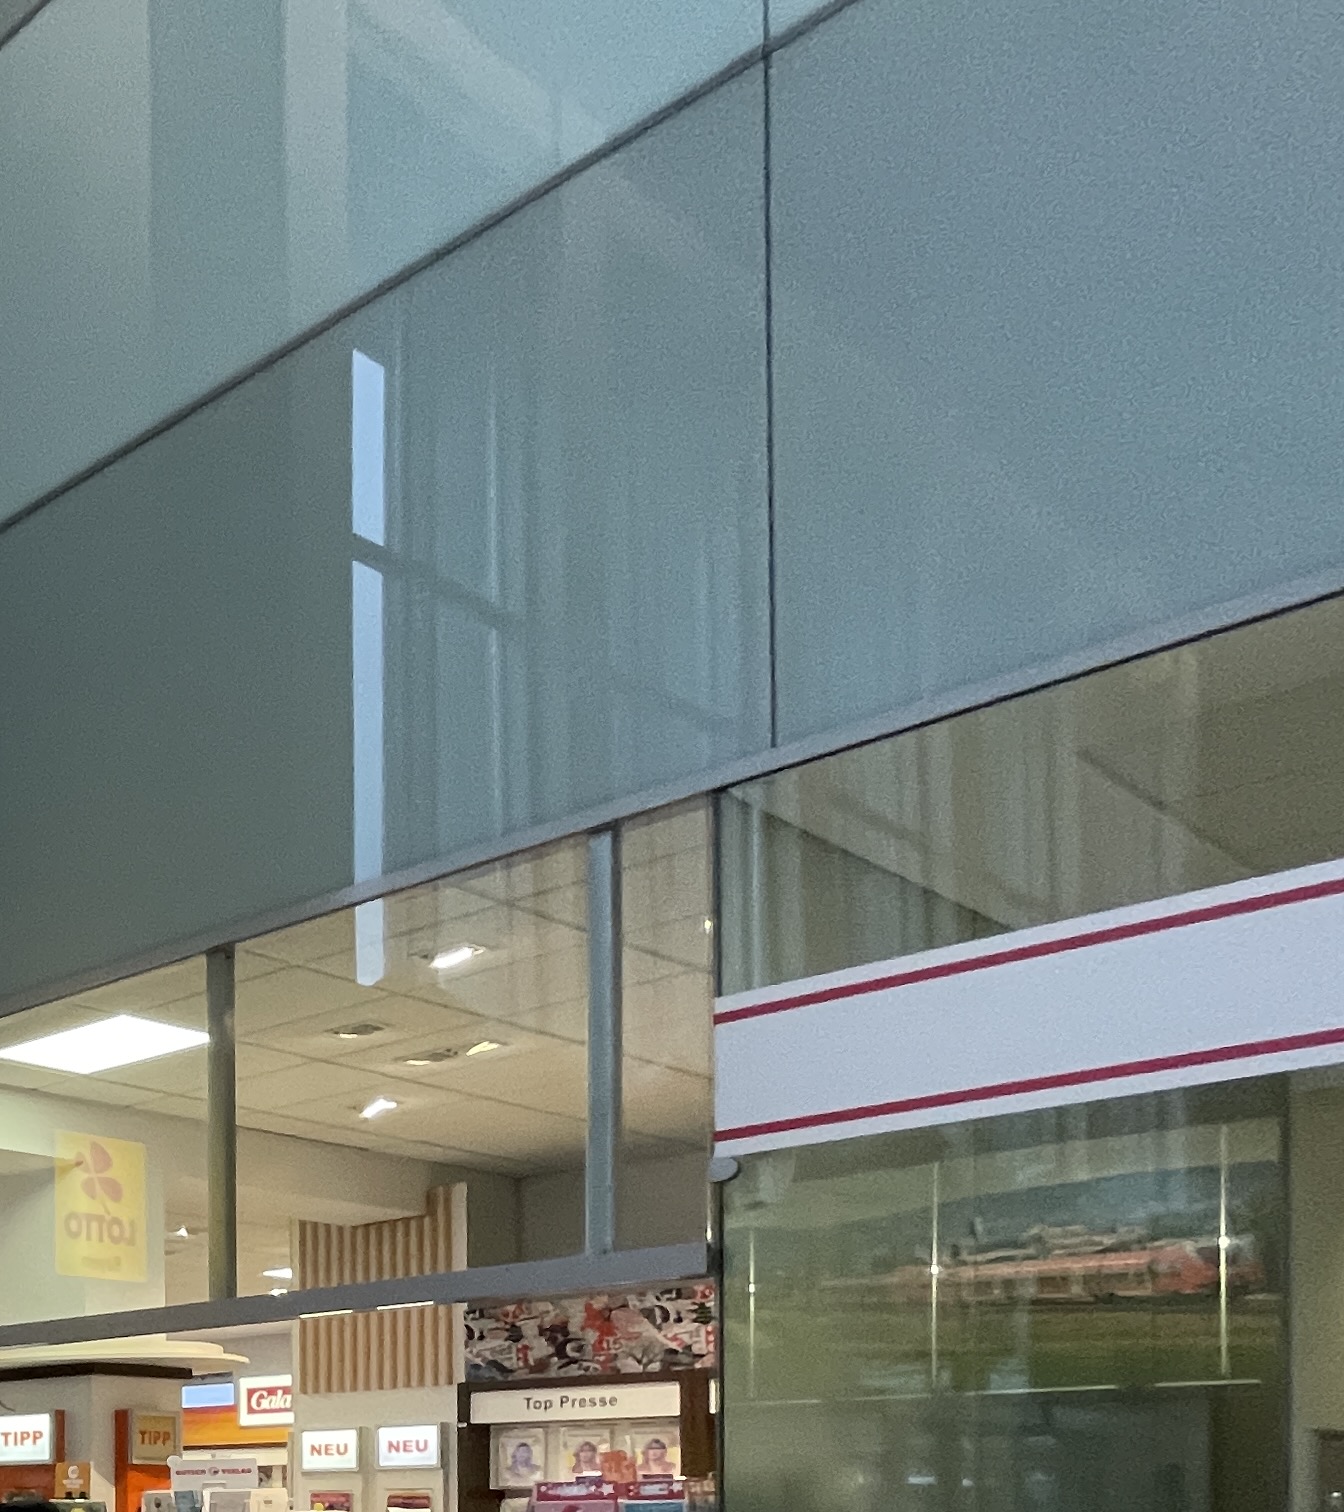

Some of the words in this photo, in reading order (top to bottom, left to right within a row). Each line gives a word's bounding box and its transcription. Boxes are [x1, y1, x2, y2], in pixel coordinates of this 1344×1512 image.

[250, 1388, 292, 1411] Gala
[524, 1396, 554, 1412] Top
[559, 1393, 619, 1409] Presse
[0, 1430, 44, 1447] TIPP
[139, 1429, 171, 1446] TIPP
[309, 1443, 349, 1457] NEU
[387, 1439, 429, 1454] NEU
